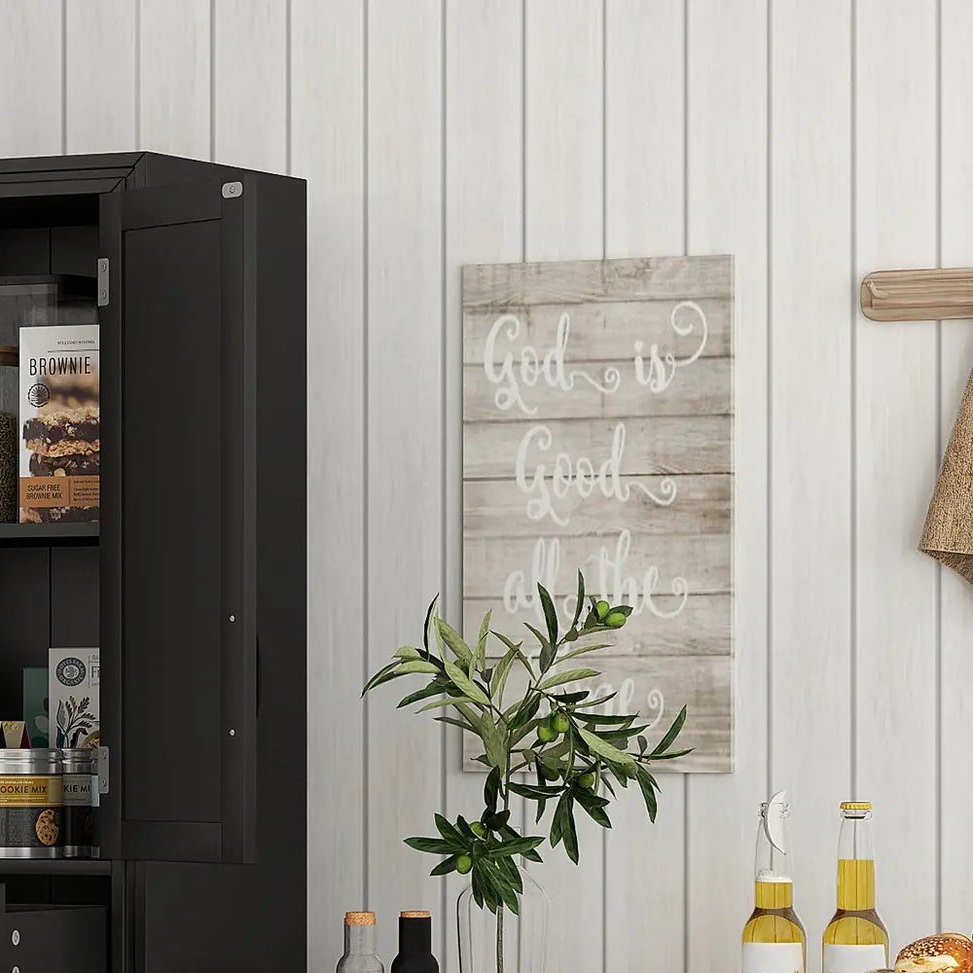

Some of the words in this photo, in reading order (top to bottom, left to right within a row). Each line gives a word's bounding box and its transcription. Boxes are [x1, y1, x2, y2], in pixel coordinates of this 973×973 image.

[29, 356, 91, 376] BROWNIE
[484, 312, 621, 414] God
[635, 301, 708, 393] is
[27, 484, 47, 492] SUGAR
[515, 422, 677, 527] Good
[585, 529, 688, 618] the
[31, 785, 47, 793] MIX
